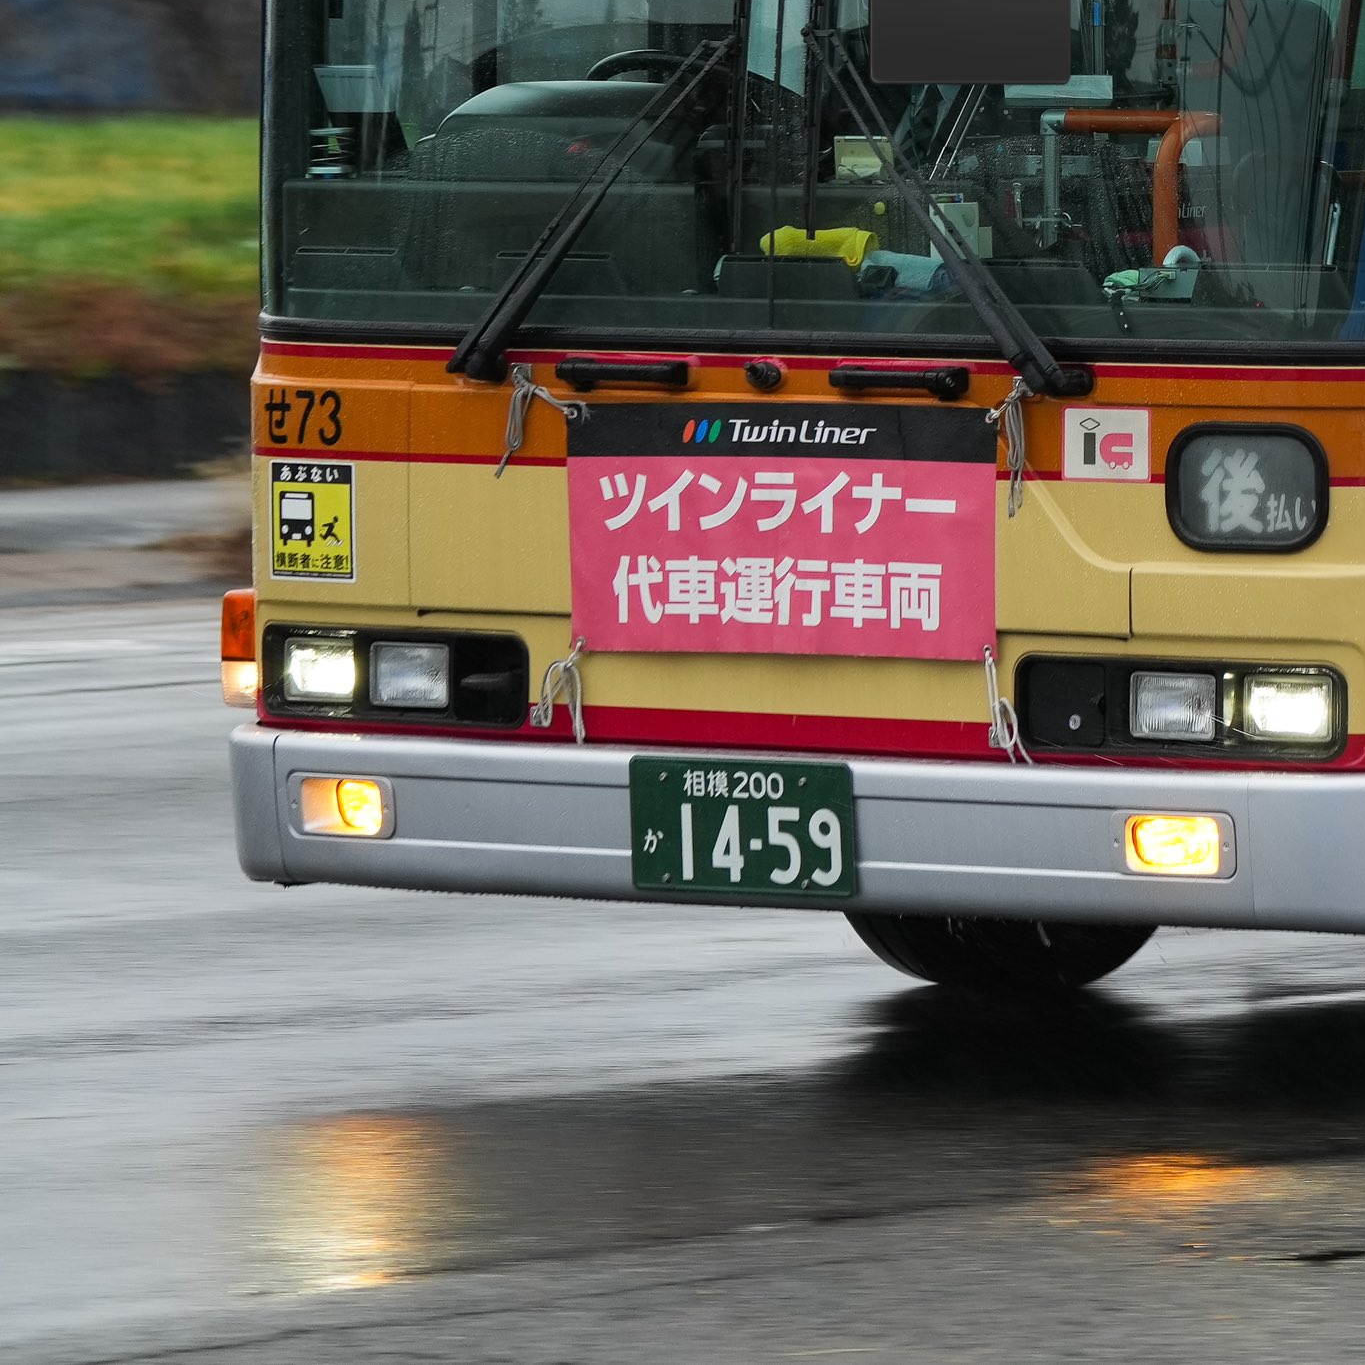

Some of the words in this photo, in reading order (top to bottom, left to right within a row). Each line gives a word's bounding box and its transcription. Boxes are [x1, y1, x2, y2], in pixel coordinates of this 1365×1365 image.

[264, 388, 342, 446] せ73
[280, 465, 340, 483] あぶない
[599, 469, 957, 535] ツインライナー
[1200, 448, 1317, 534] 後払い
[612, 554, 943, 632] 代車運行車両
[643, 827, 664, 854] か
[681, 803, 843, 887] 14-59
